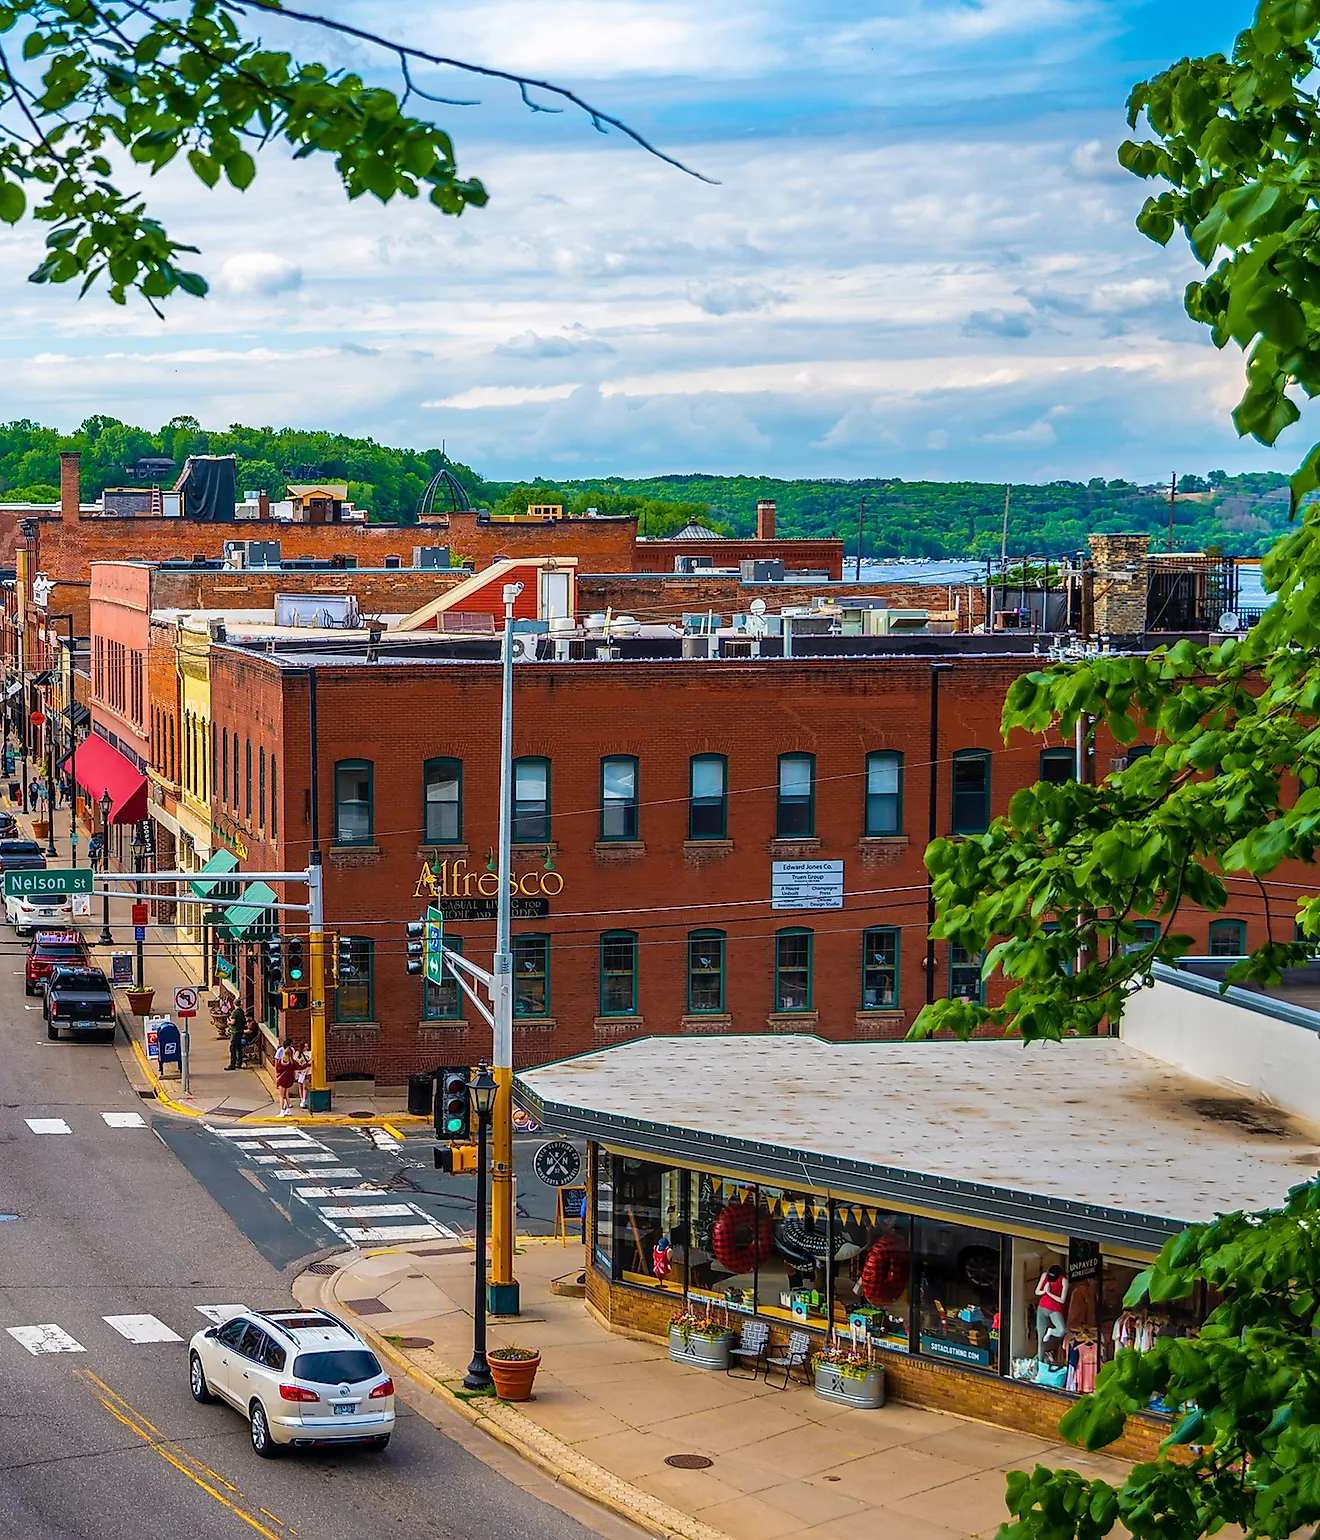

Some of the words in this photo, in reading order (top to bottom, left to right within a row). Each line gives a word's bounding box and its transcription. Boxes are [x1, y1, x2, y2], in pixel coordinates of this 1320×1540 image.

[11, 875, 66, 891] Nelson
[73, 878, 86, 889] St
[412, 858, 564, 898] Alfresco
[440, 900, 478, 910] CASUAL
[1069, 1257, 1099, 1271] UNPAVED
[930, 1342, 980, 1361] SOTACLOTHING.COM
